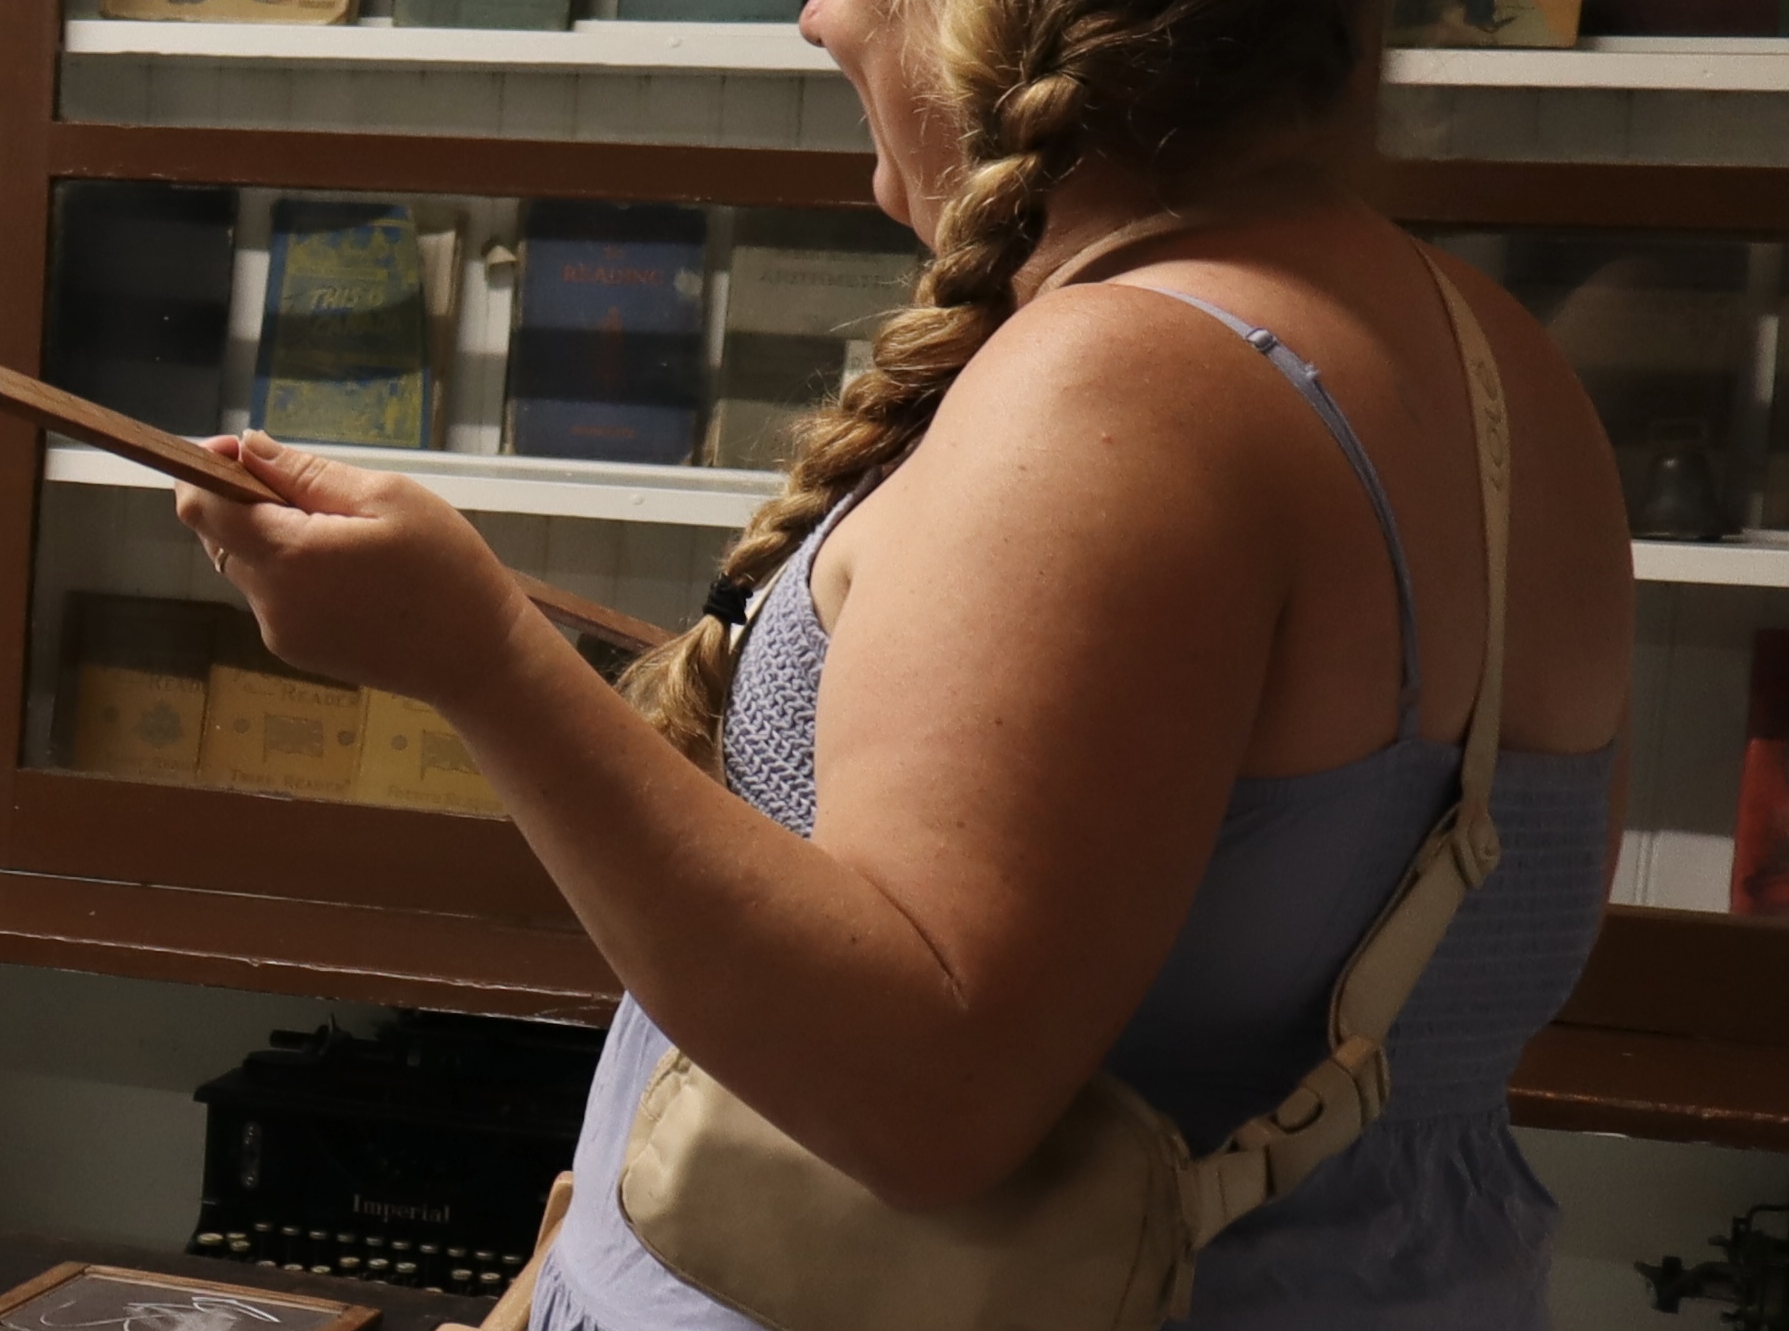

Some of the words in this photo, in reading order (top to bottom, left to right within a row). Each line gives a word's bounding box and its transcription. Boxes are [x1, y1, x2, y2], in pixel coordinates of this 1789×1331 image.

[561, 264, 665, 287] READING
[310, 286, 360, 310] THIS
[351, 1192, 452, 1224] Imperial
